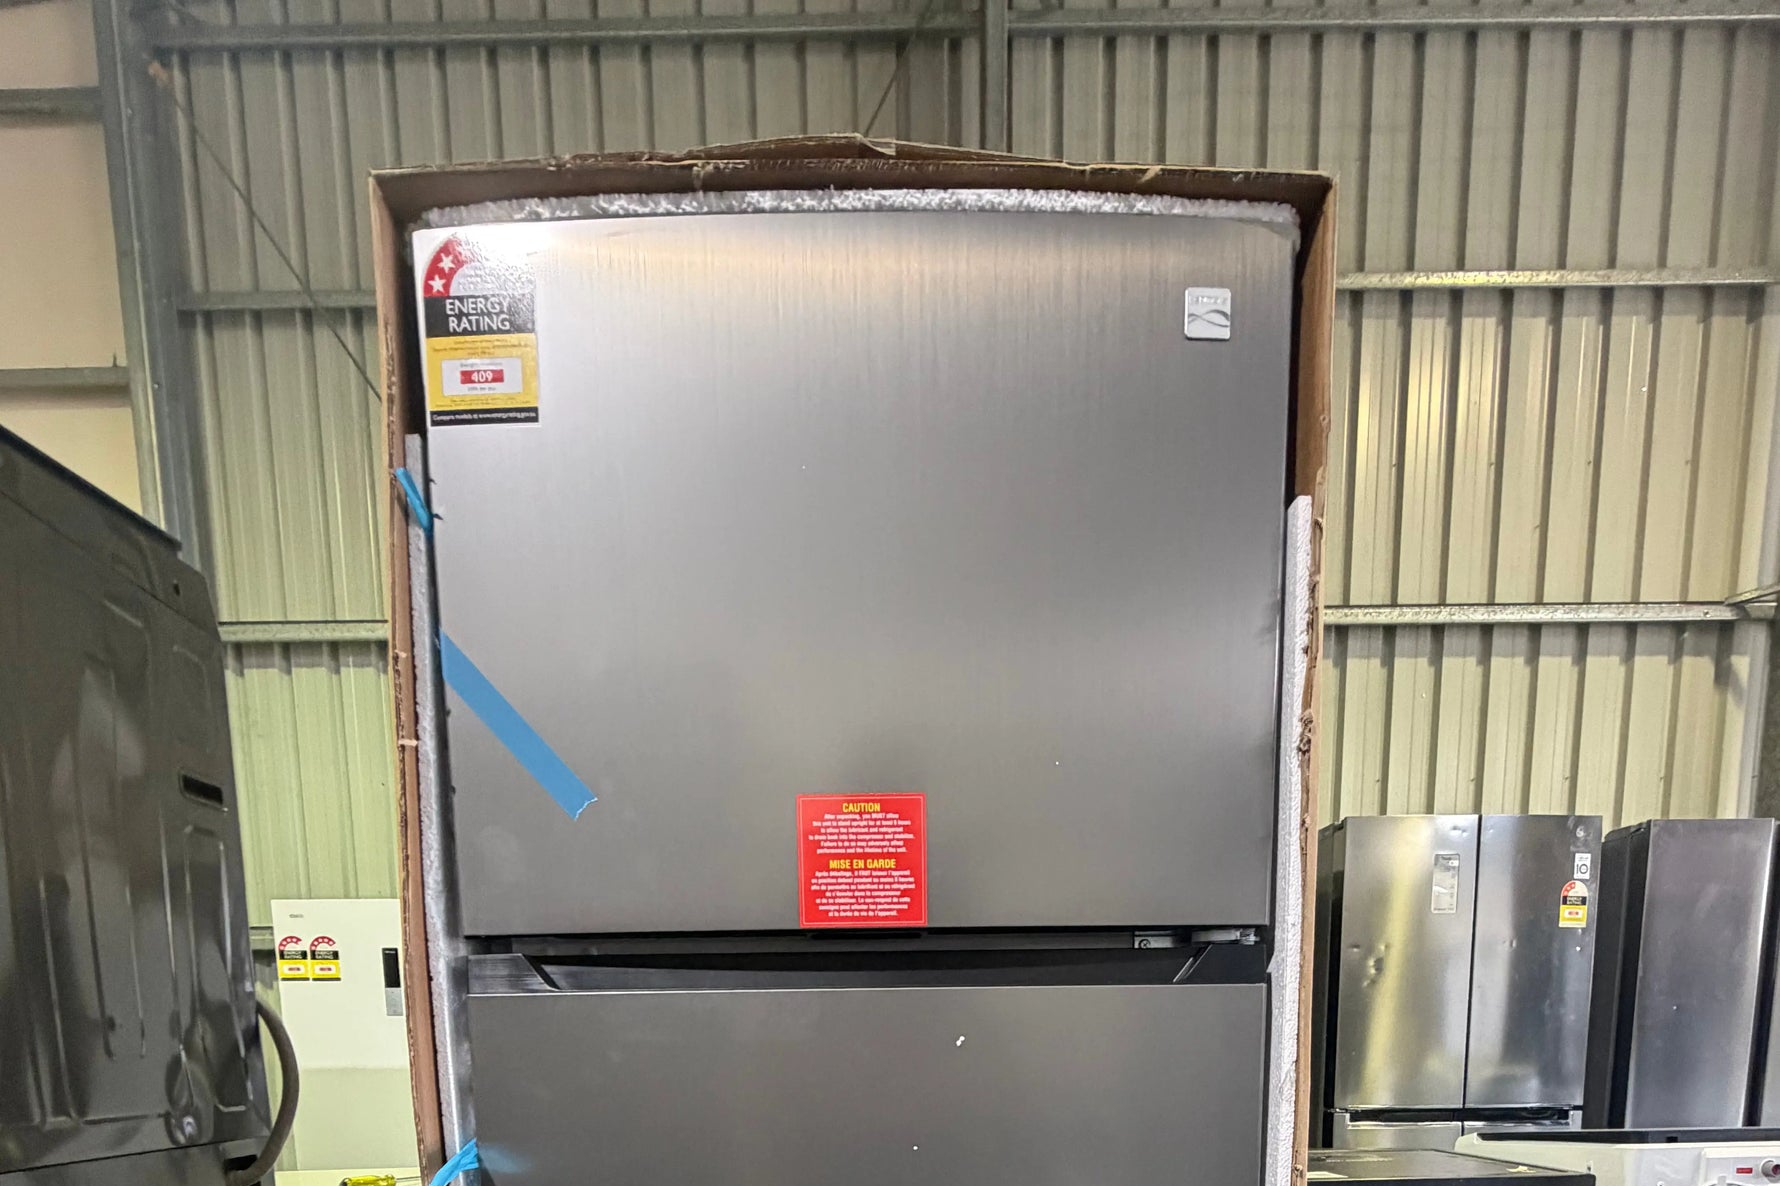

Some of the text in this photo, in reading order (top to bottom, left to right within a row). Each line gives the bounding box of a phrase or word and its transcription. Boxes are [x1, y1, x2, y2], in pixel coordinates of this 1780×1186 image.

[445, 298, 510, 315] ENERGY
[448, 315, 511, 333] RATING
[471, 370, 493, 382] 409
[842, 803, 880, 812] CAUTION
[829, 859, 896, 869] MISE EN GARDE
